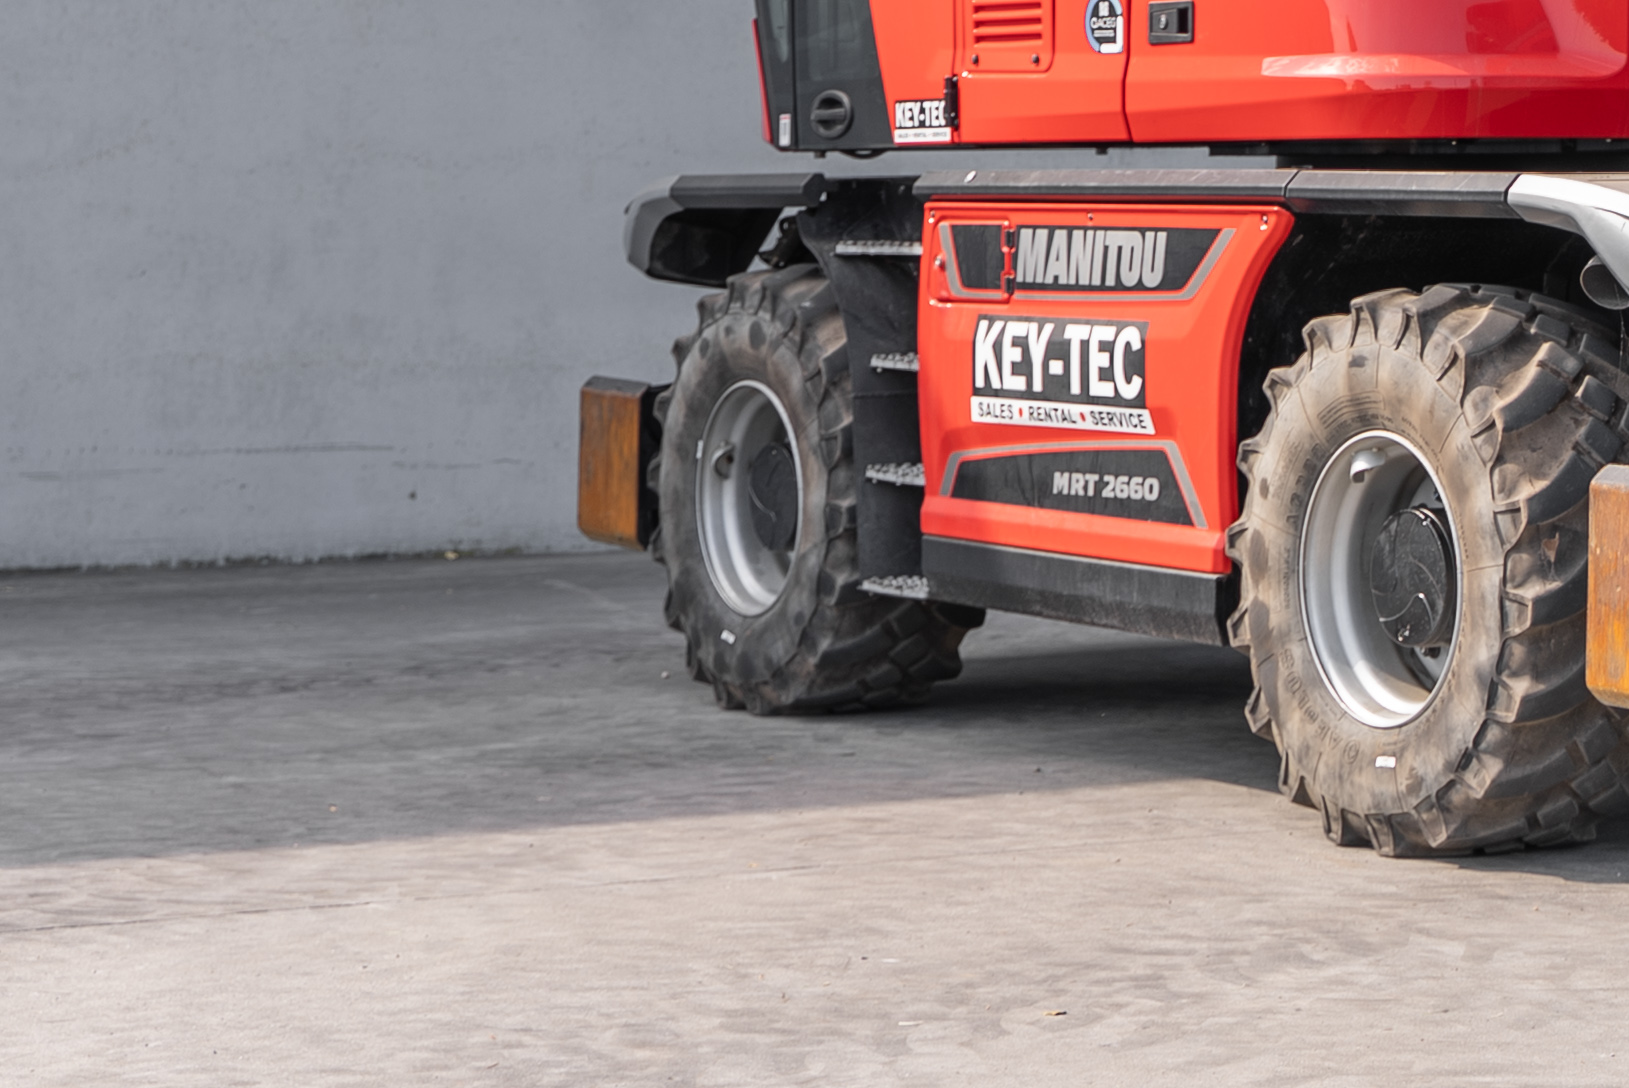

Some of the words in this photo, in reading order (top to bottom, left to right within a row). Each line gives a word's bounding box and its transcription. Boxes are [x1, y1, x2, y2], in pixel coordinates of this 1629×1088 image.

[1015, 228, 1167, 288] MANITOU
[974, 319, 1143, 400] KEY-TEC
[978, 402, 1014, 420] SALES
[1028, 406, 1077, 425] RENTAL
[1091, 410, 1147, 429] SERVICE
[1052, 471, 1099, 497] MRT
[1101, 474, 1160, 501] 2660
